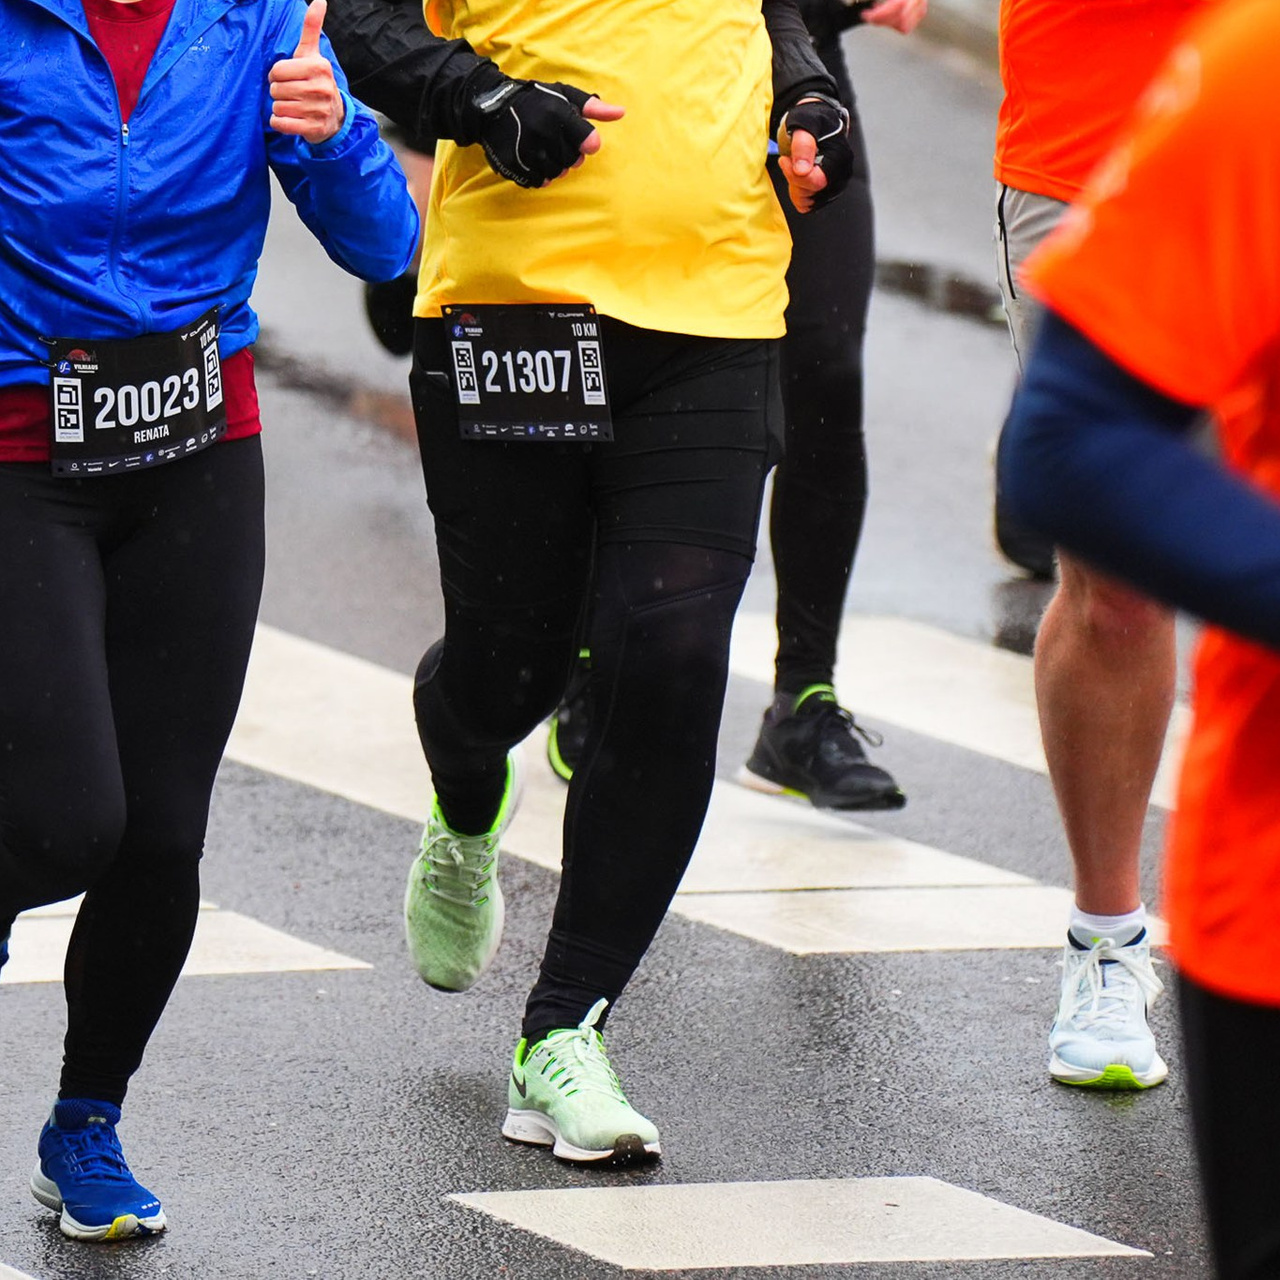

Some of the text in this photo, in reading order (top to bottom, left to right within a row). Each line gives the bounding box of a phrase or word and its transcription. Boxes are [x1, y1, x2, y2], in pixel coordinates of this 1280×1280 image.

[571, 322, 598, 337] 10 KM
[200, 333, 208, 349] 10
[73, 363, 99, 371] VILNIAUS
[481, 349, 572, 394] 21307
[93, 367, 200, 430] 20023
[133, 424, 170, 444] RENATA
